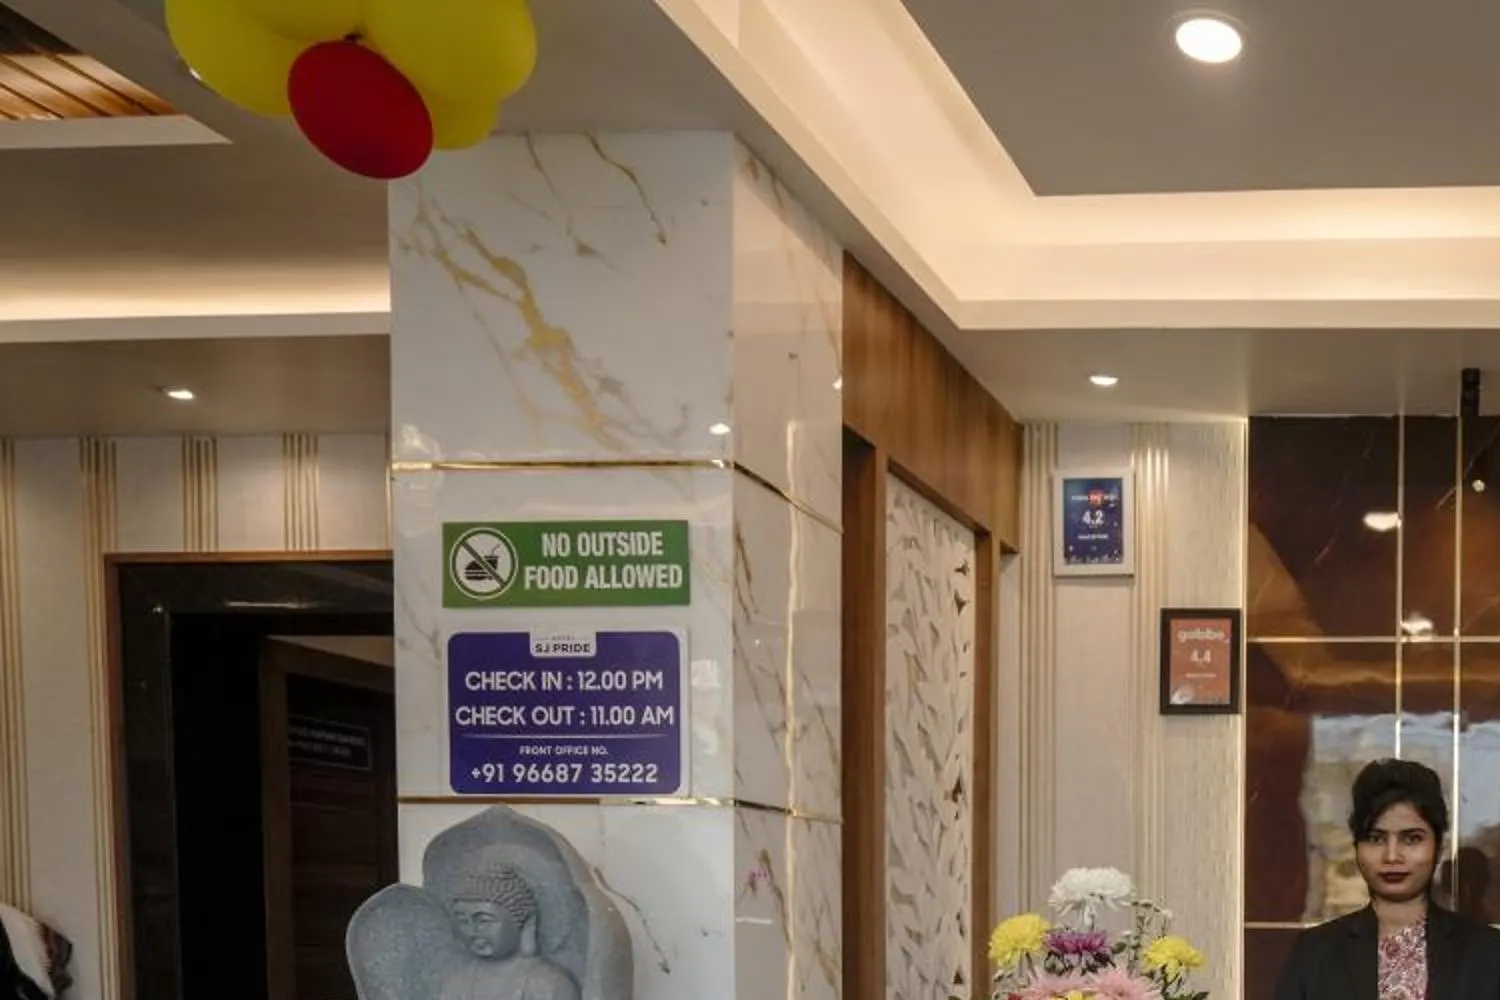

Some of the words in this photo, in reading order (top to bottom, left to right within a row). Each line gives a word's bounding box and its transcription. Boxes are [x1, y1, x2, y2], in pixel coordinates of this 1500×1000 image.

[541, 533, 570, 556] NO
[577, 532, 663, 556] OUTSIDE
[524, 566, 578, 589] FOOD
[584, 564, 682, 588] ALLOWED
[535, 643, 551, 653] SJ
[552, 643, 591, 653] PRIDE
[465, 671, 536, 691] CHECK
[541, 671, 562, 690] IN
[578, 671, 627, 690] 12.00
[632, 671, 663, 689] PM
[455, 706, 526, 726] CHECK
[531, 706, 574, 725] OUT
[590, 706, 636, 725] 11.00
[641, 706, 674, 724] AM
[519, 745, 552, 755] FRONT
[554, 745, 588, 755] OFFICE
[470, 764, 504, 784] +91
[512, 763, 582, 783] 96687
[591, 763, 658, 783] 35222
